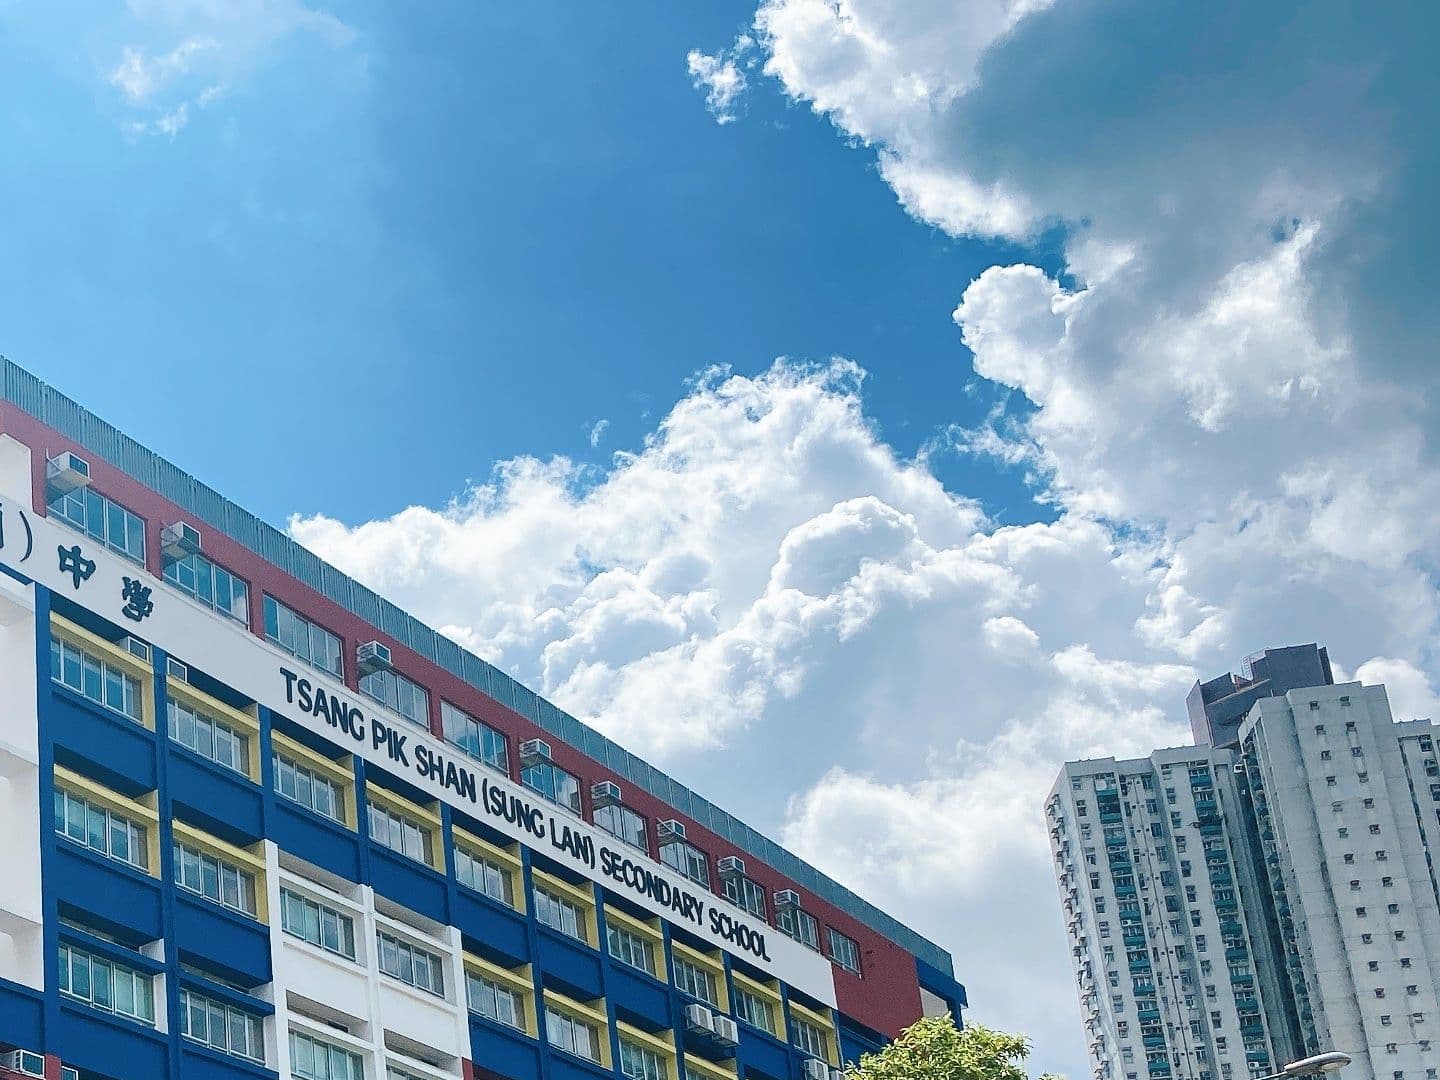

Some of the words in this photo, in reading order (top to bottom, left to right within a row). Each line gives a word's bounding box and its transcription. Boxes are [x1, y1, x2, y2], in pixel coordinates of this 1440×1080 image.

[279, 667, 365, 742] TSANG
[371, 718, 408, 768] PIK
[414, 743, 477, 804] SHAN
[481, 777, 546, 842] (SUNG
[549, 817, 596, 871] LAN)
[600, 848, 705, 927] SECONDARY
[708, 906, 772, 964] SCHOOL
